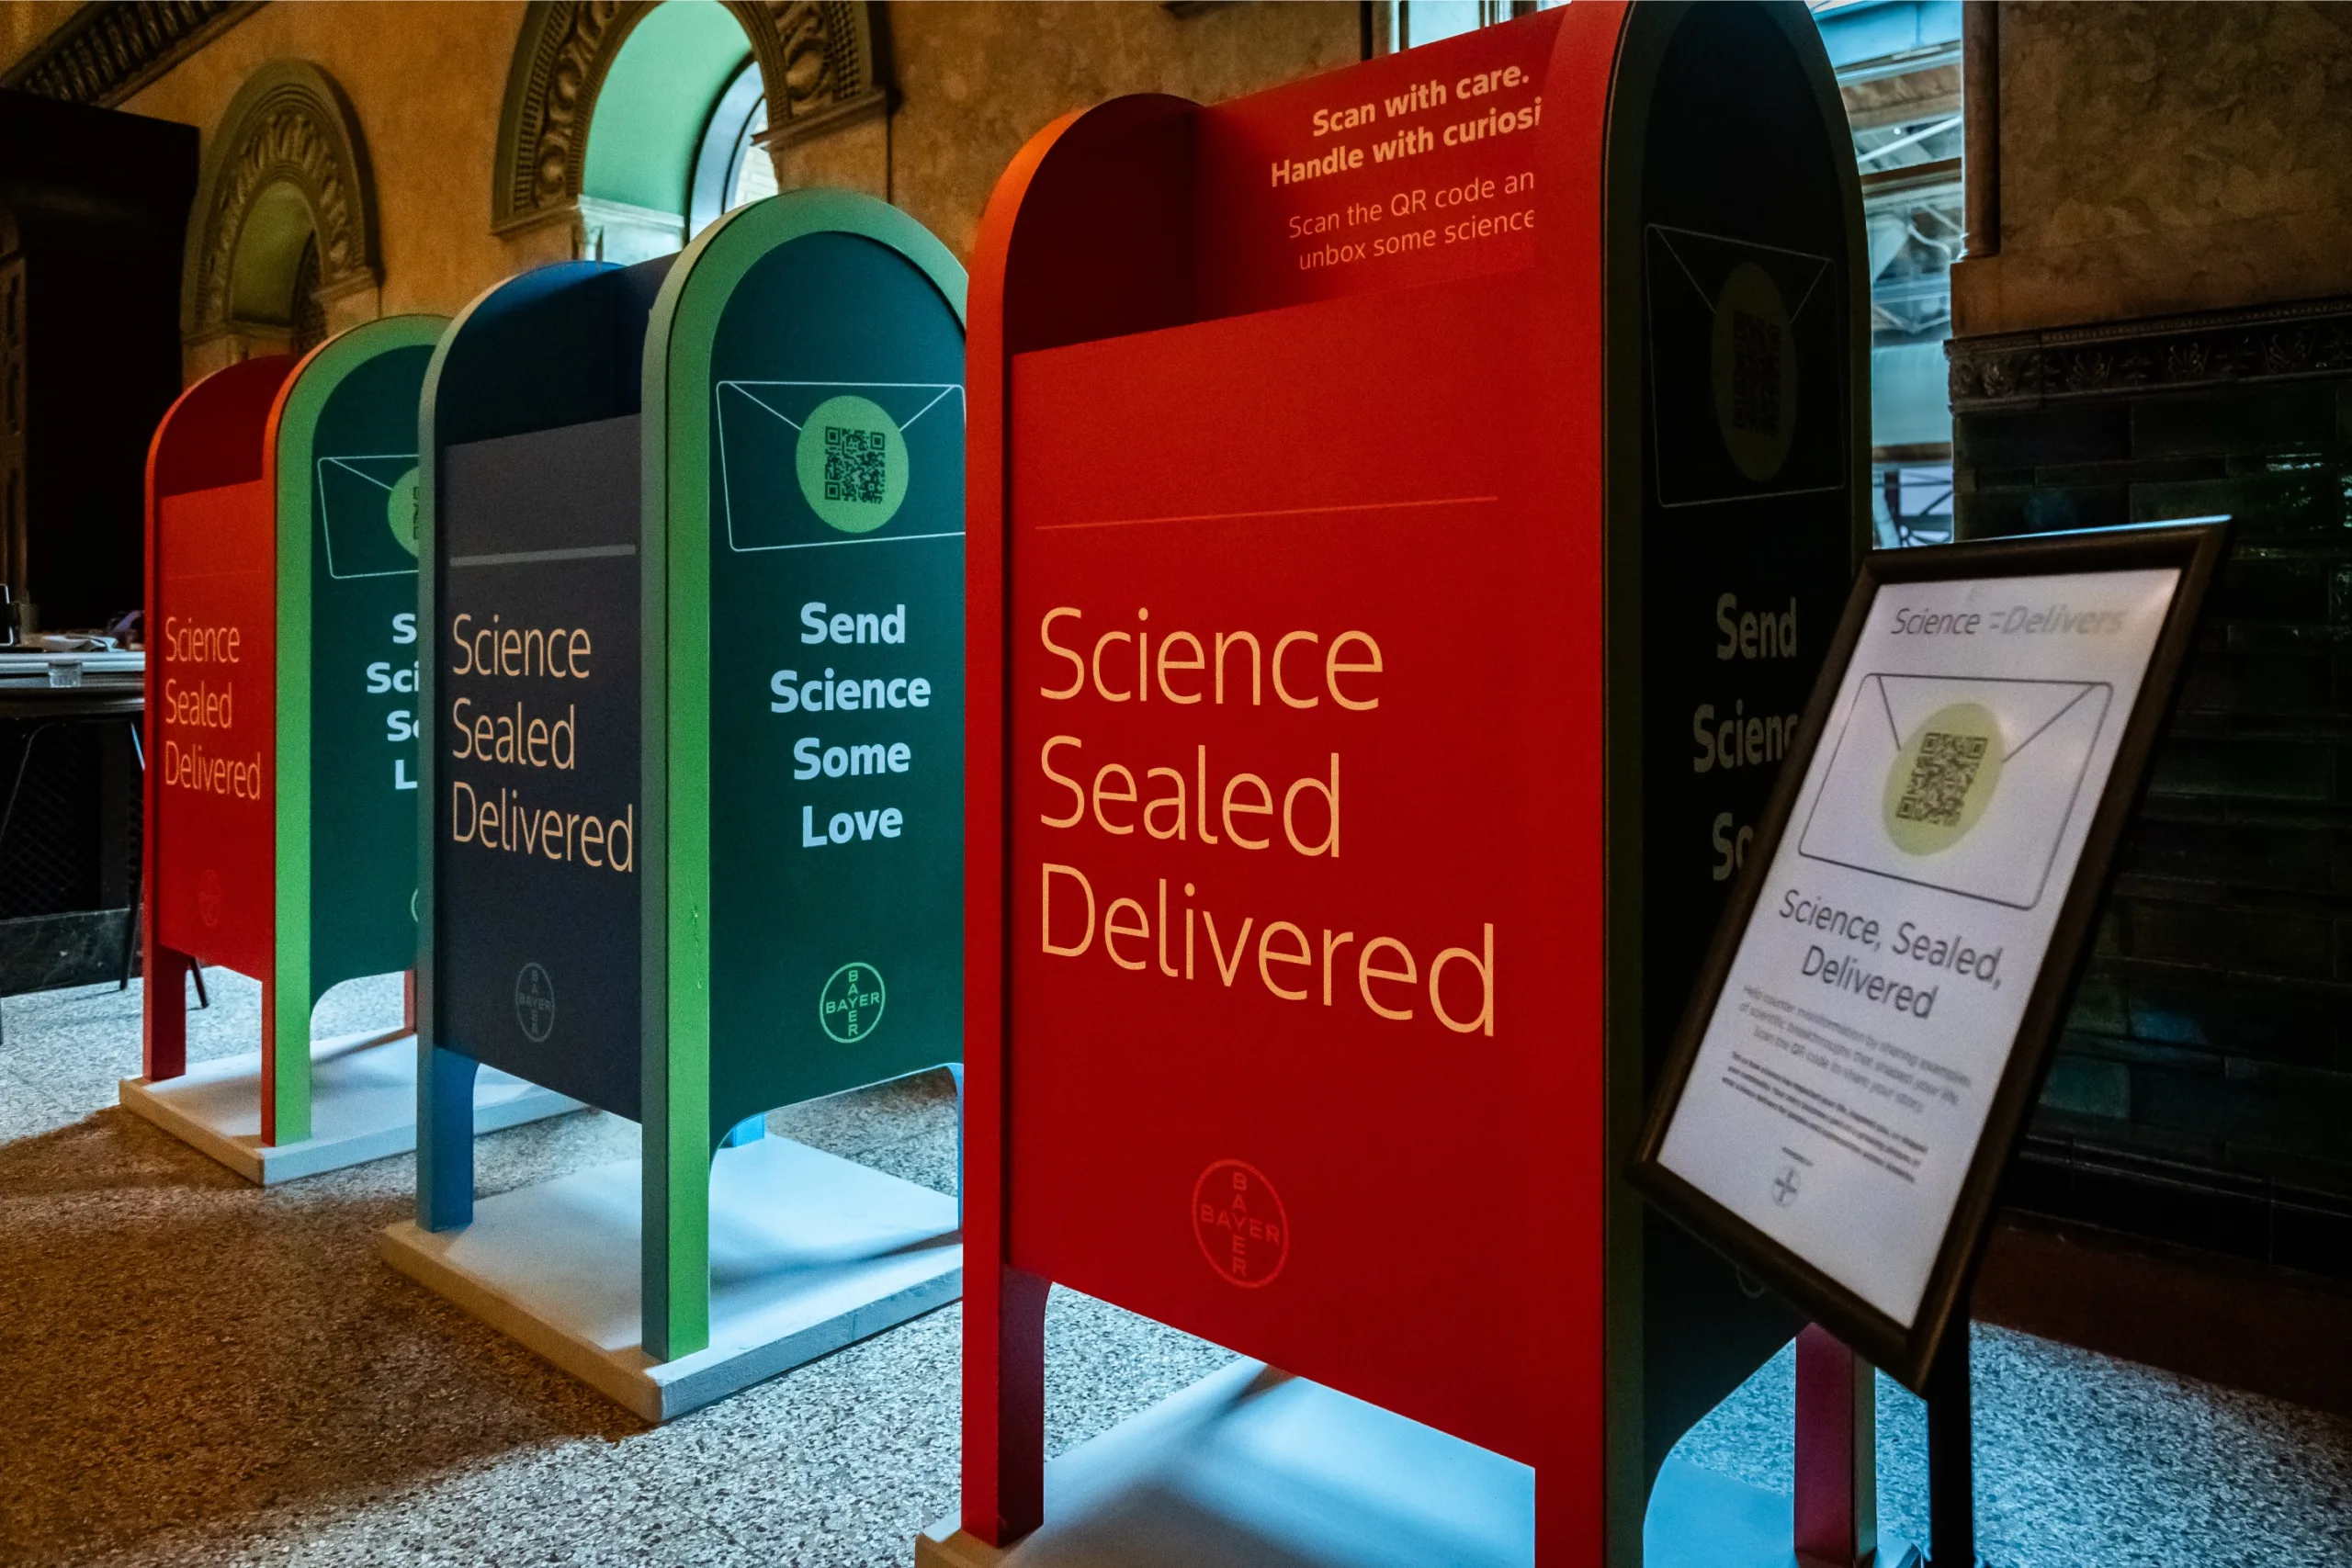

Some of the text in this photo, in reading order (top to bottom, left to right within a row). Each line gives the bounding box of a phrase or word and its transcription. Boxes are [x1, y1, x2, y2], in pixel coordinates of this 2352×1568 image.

[1312, 65, 1530, 137] Scan with care.
[1271, 96, 1542, 187] Handle with curiosi
[1289, 171, 1534, 239] Scan the QR code an
[1299, 209, 1534, 270] unbox some science
[165, 616, 240, 663] Science
[453, 614, 591, 678] Science
[800, 602, 905, 644] Send
[1716, 592, 1797, 660] Send
[1891, 607, 1981, 635] Science
[770, 667, 932, 713] Science
[1040, 606, 1384, 711] Science
[165, 678, 232, 730] Sealed
[453, 697, 574, 770] Sealed
[1693, 698, 1798, 773] Scienc
[165, 740, 262, 801] Delivered
[793, 737, 911, 780] Some
[453, 781, 633, 873] Delivered
[802, 806, 904, 848] Love
[1040, 735, 1340, 858] Sealed
[1042, 863, 1494, 1037] Delivered
[1779, 889, 2004, 990] Science, Sealed,
[825, 991, 880, 1015] BAYER
[848, 969, 859, 1037] BAYER
[1802, 944, 1939, 1020] Delivered
[1200, 1203, 1280, 1246] BAYER
[1232, 1171, 1248, 1277] BAYER
